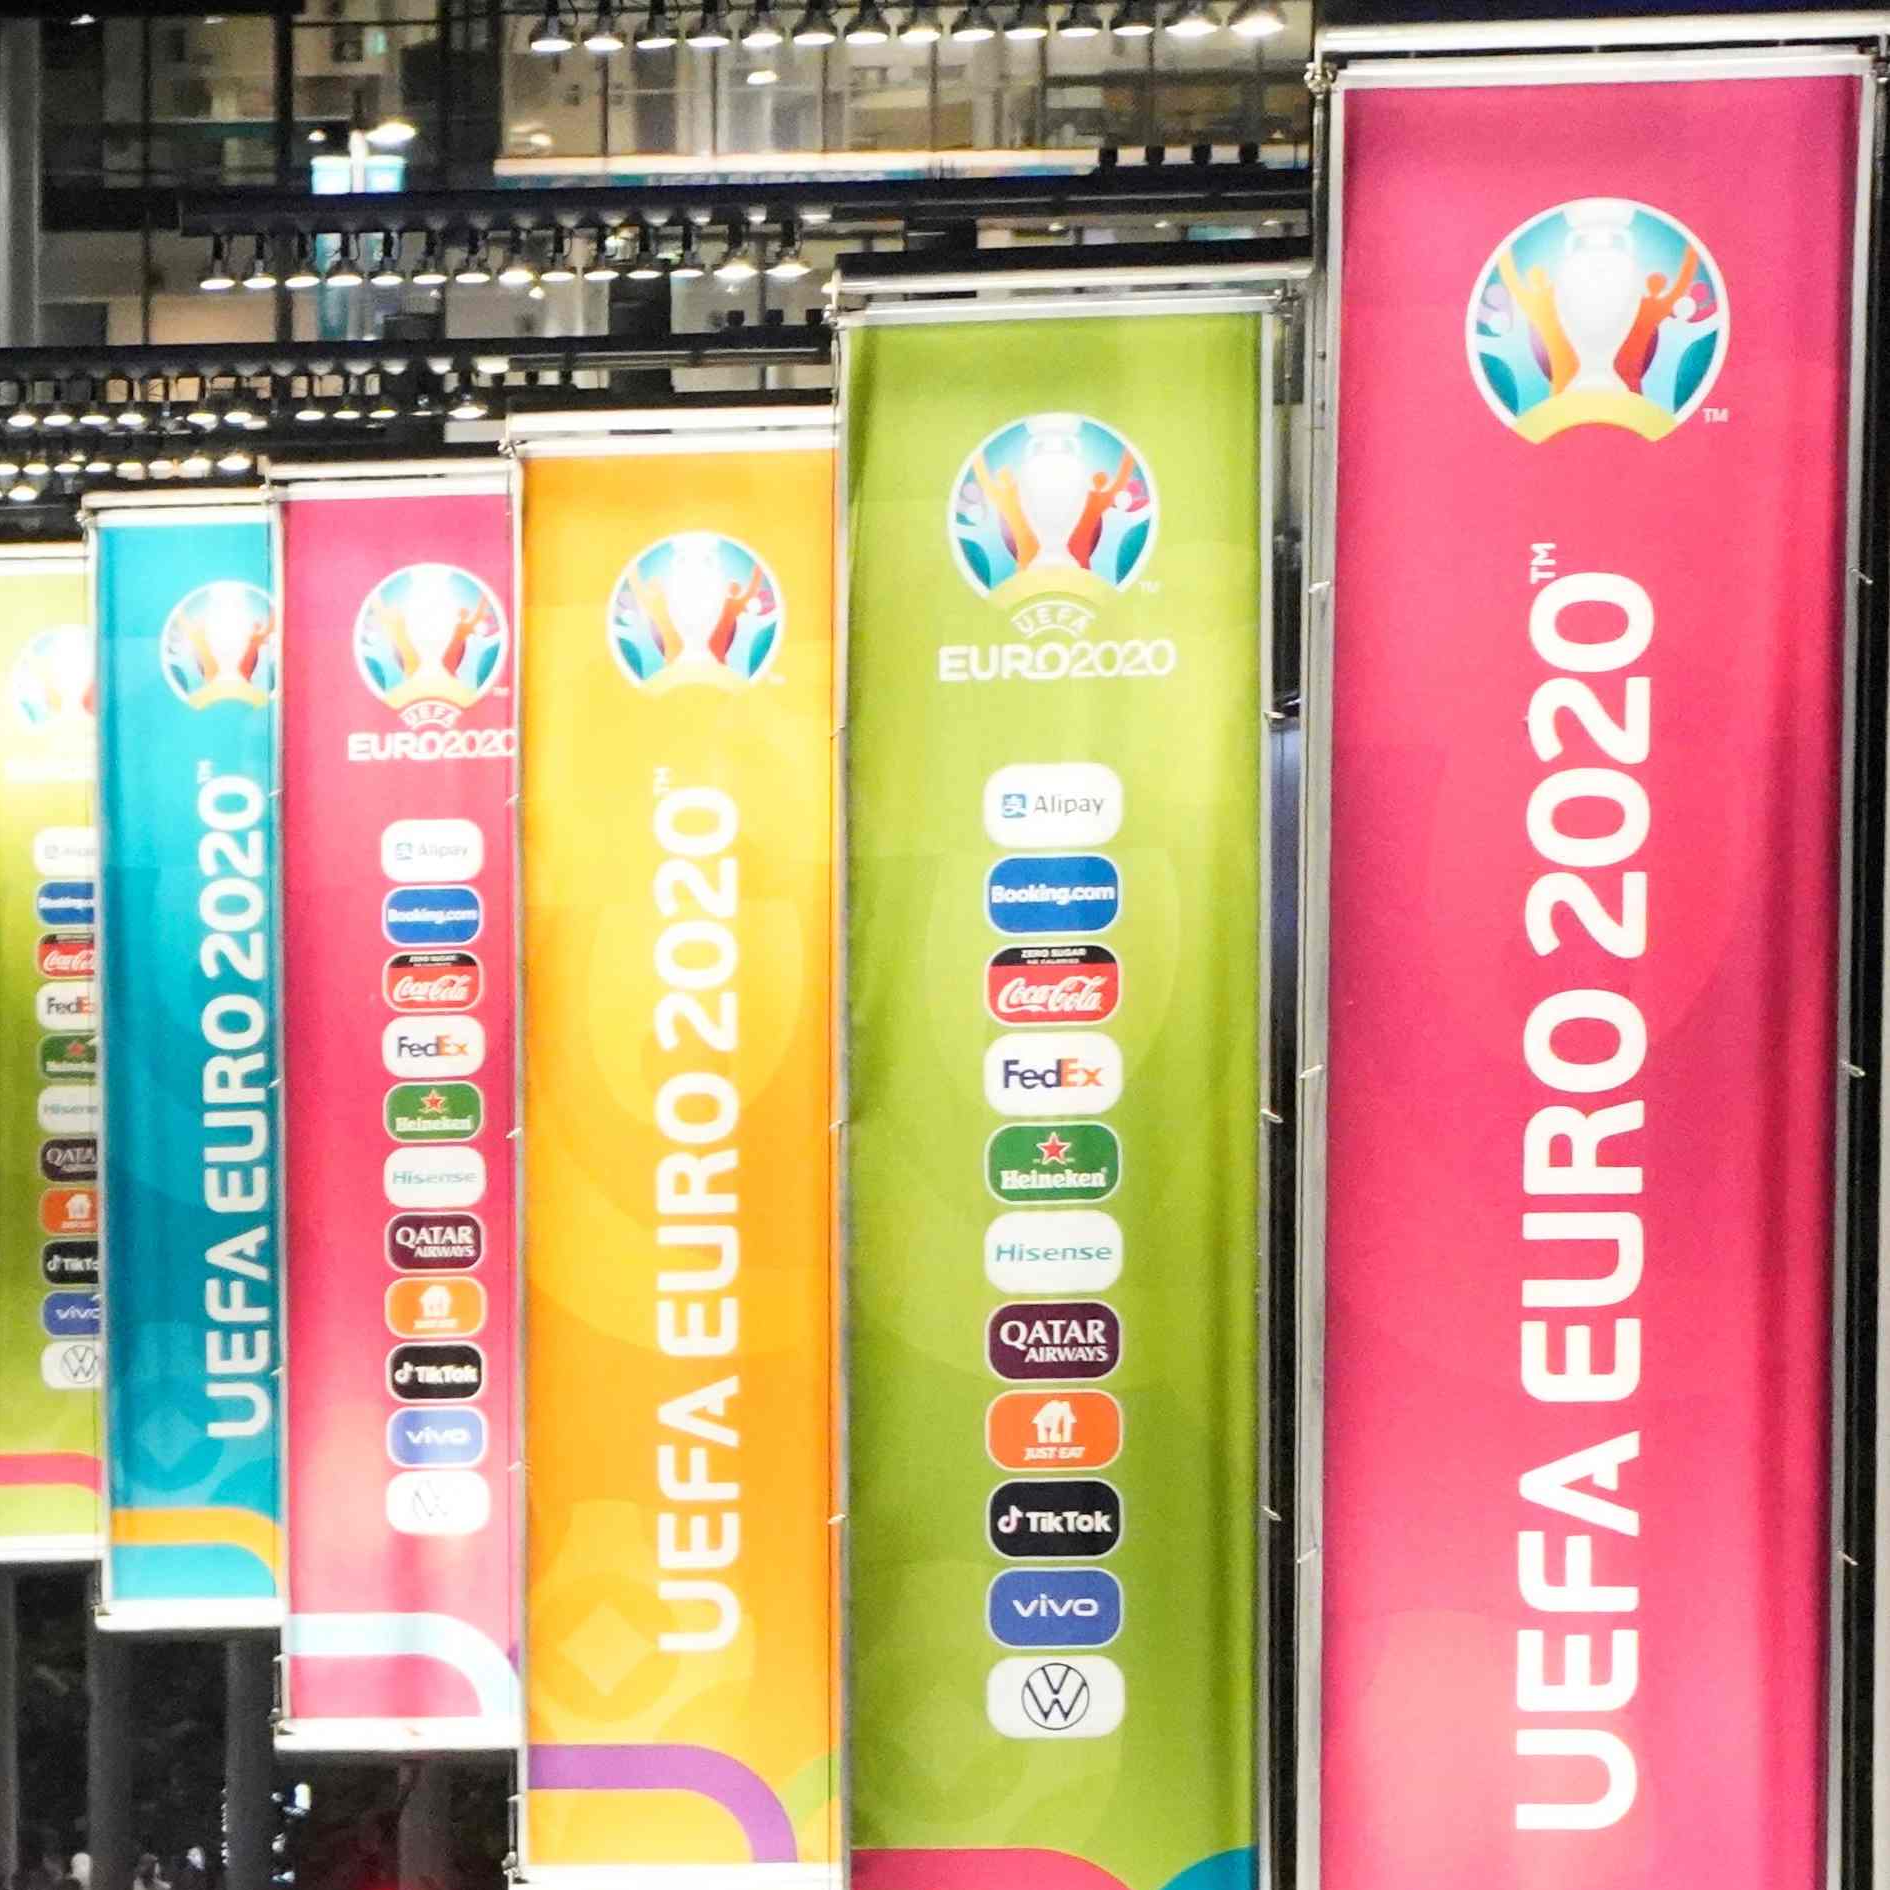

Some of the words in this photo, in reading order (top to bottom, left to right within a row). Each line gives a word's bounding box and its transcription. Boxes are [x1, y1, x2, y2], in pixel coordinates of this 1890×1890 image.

[1702, 407, 1729, 423] TM
[1013, 604, 1091, 637] UEFA
[936, 638, 1176, 683] EURO2020
[401, 701, 462, 728] UEFA
[1524, 571, 1655, 960] 2020
[1034, 794, 1105, 816] Alipay
[196, 774, 266, 983] 2020
[990, 883, 1115, 906] Booking.com
[387, 906, 478, 927] Booking.com
[652, 786, 739, 1053] 2020
[47, 997, 94, 1015] FedE
[397, 1034, 468, 1057] FedEx
[1003, 1057, 1103, 1090] FedEx
[200, 995, 269, 1213] EURO
[395, 1114, 472, 1132] Heineken
[46, 1148, 96, 1168] QATA
[392, 1170, 477, 1185] Hisense
[1000, 1168, 1107, 1188] Heineken
[1520, 989, 1649, 1403] EURO
[654, 1071, 740, 1358] EURO
[396, 1225, 474, 1247] QATAR
[415, 1245, 476, 1259] AIRWAYS
[994, 1241, 1113, 1262] Hisense
[205, 1224, 272, 1438] UEFA
[1000, 1319, 1105, 1347] QATAR
[1025, 1346, 1109, 1363] AIRWAYS
[416, 1365, 478, 1384] TikTok
[406, 1426, 470, 1446] vivo
[1023, 1447, 1054, 1460] JUST
[1055, 1446, 1086, 1459] EAT
[657, 1374, 741, 1654] UEFA
[1026, 1510, 1112, 1533] TikTok
[1013, 1592, 1099, 1617] vivo
[1514, 1429, 1641, 1831] UEFA
